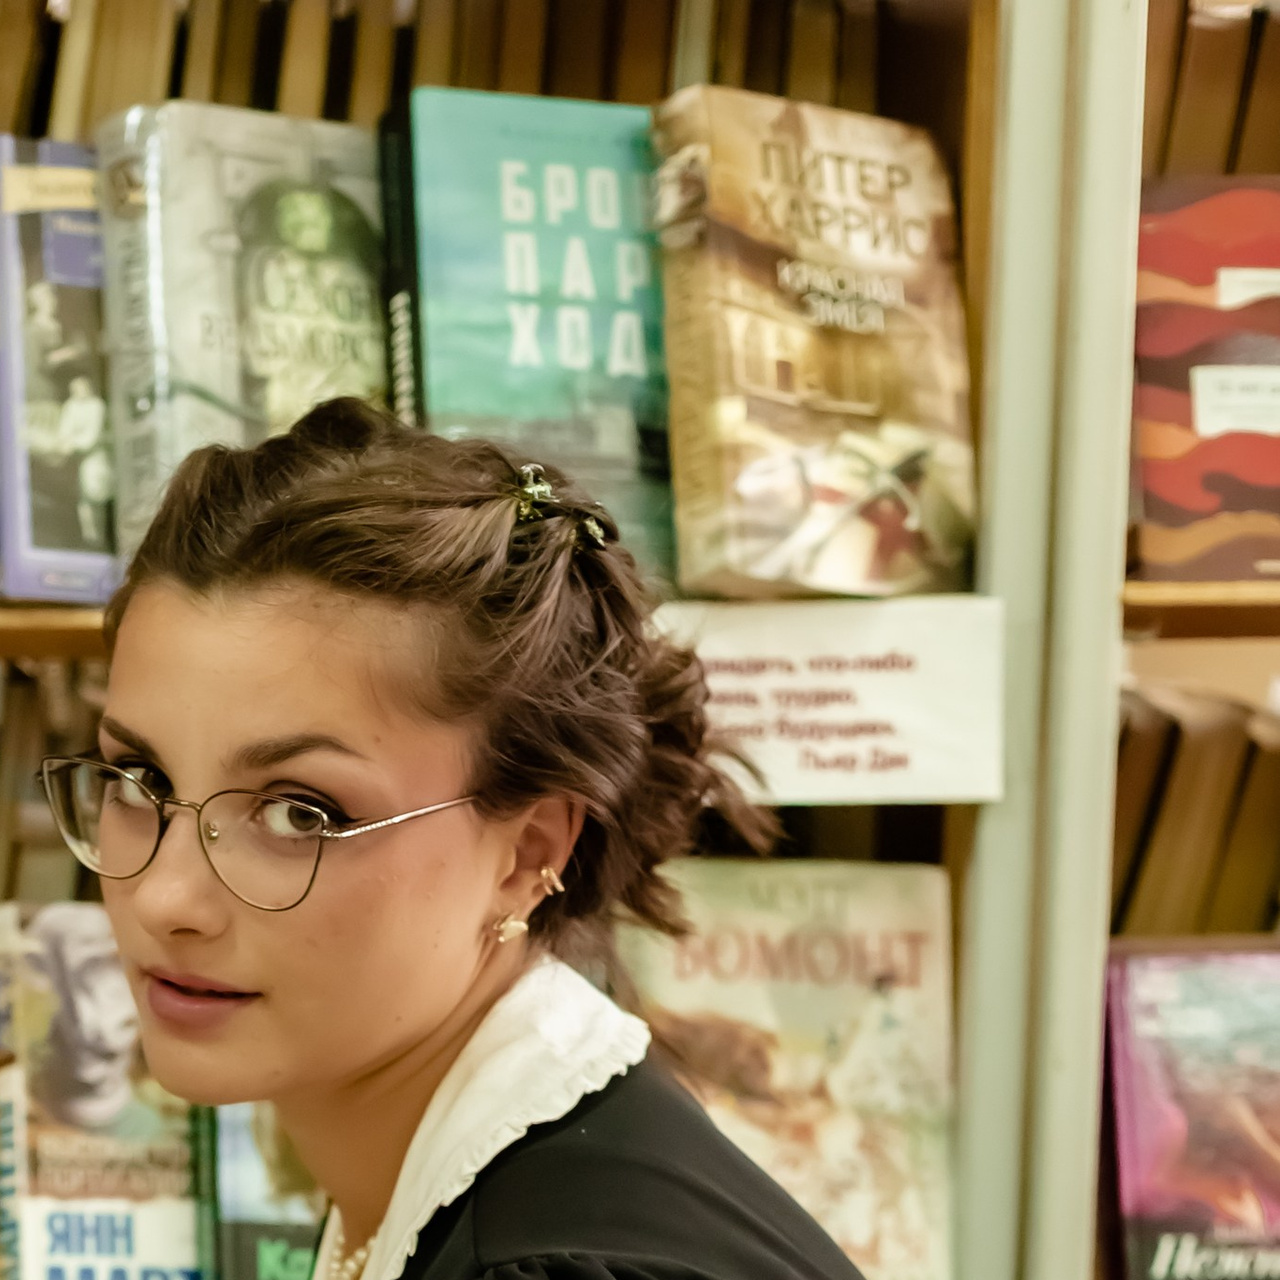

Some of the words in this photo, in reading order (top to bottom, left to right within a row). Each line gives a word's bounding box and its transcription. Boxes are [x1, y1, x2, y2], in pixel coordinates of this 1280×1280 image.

[760, 142, 912, 194] ПИТЕР
[748, 190, 929, 254] ХАРРИС
[502, 230, 651, 303] ПАР
[506, 302, 648, 379] ХОД
[45, 1211, 136, 1259] ЯНН
